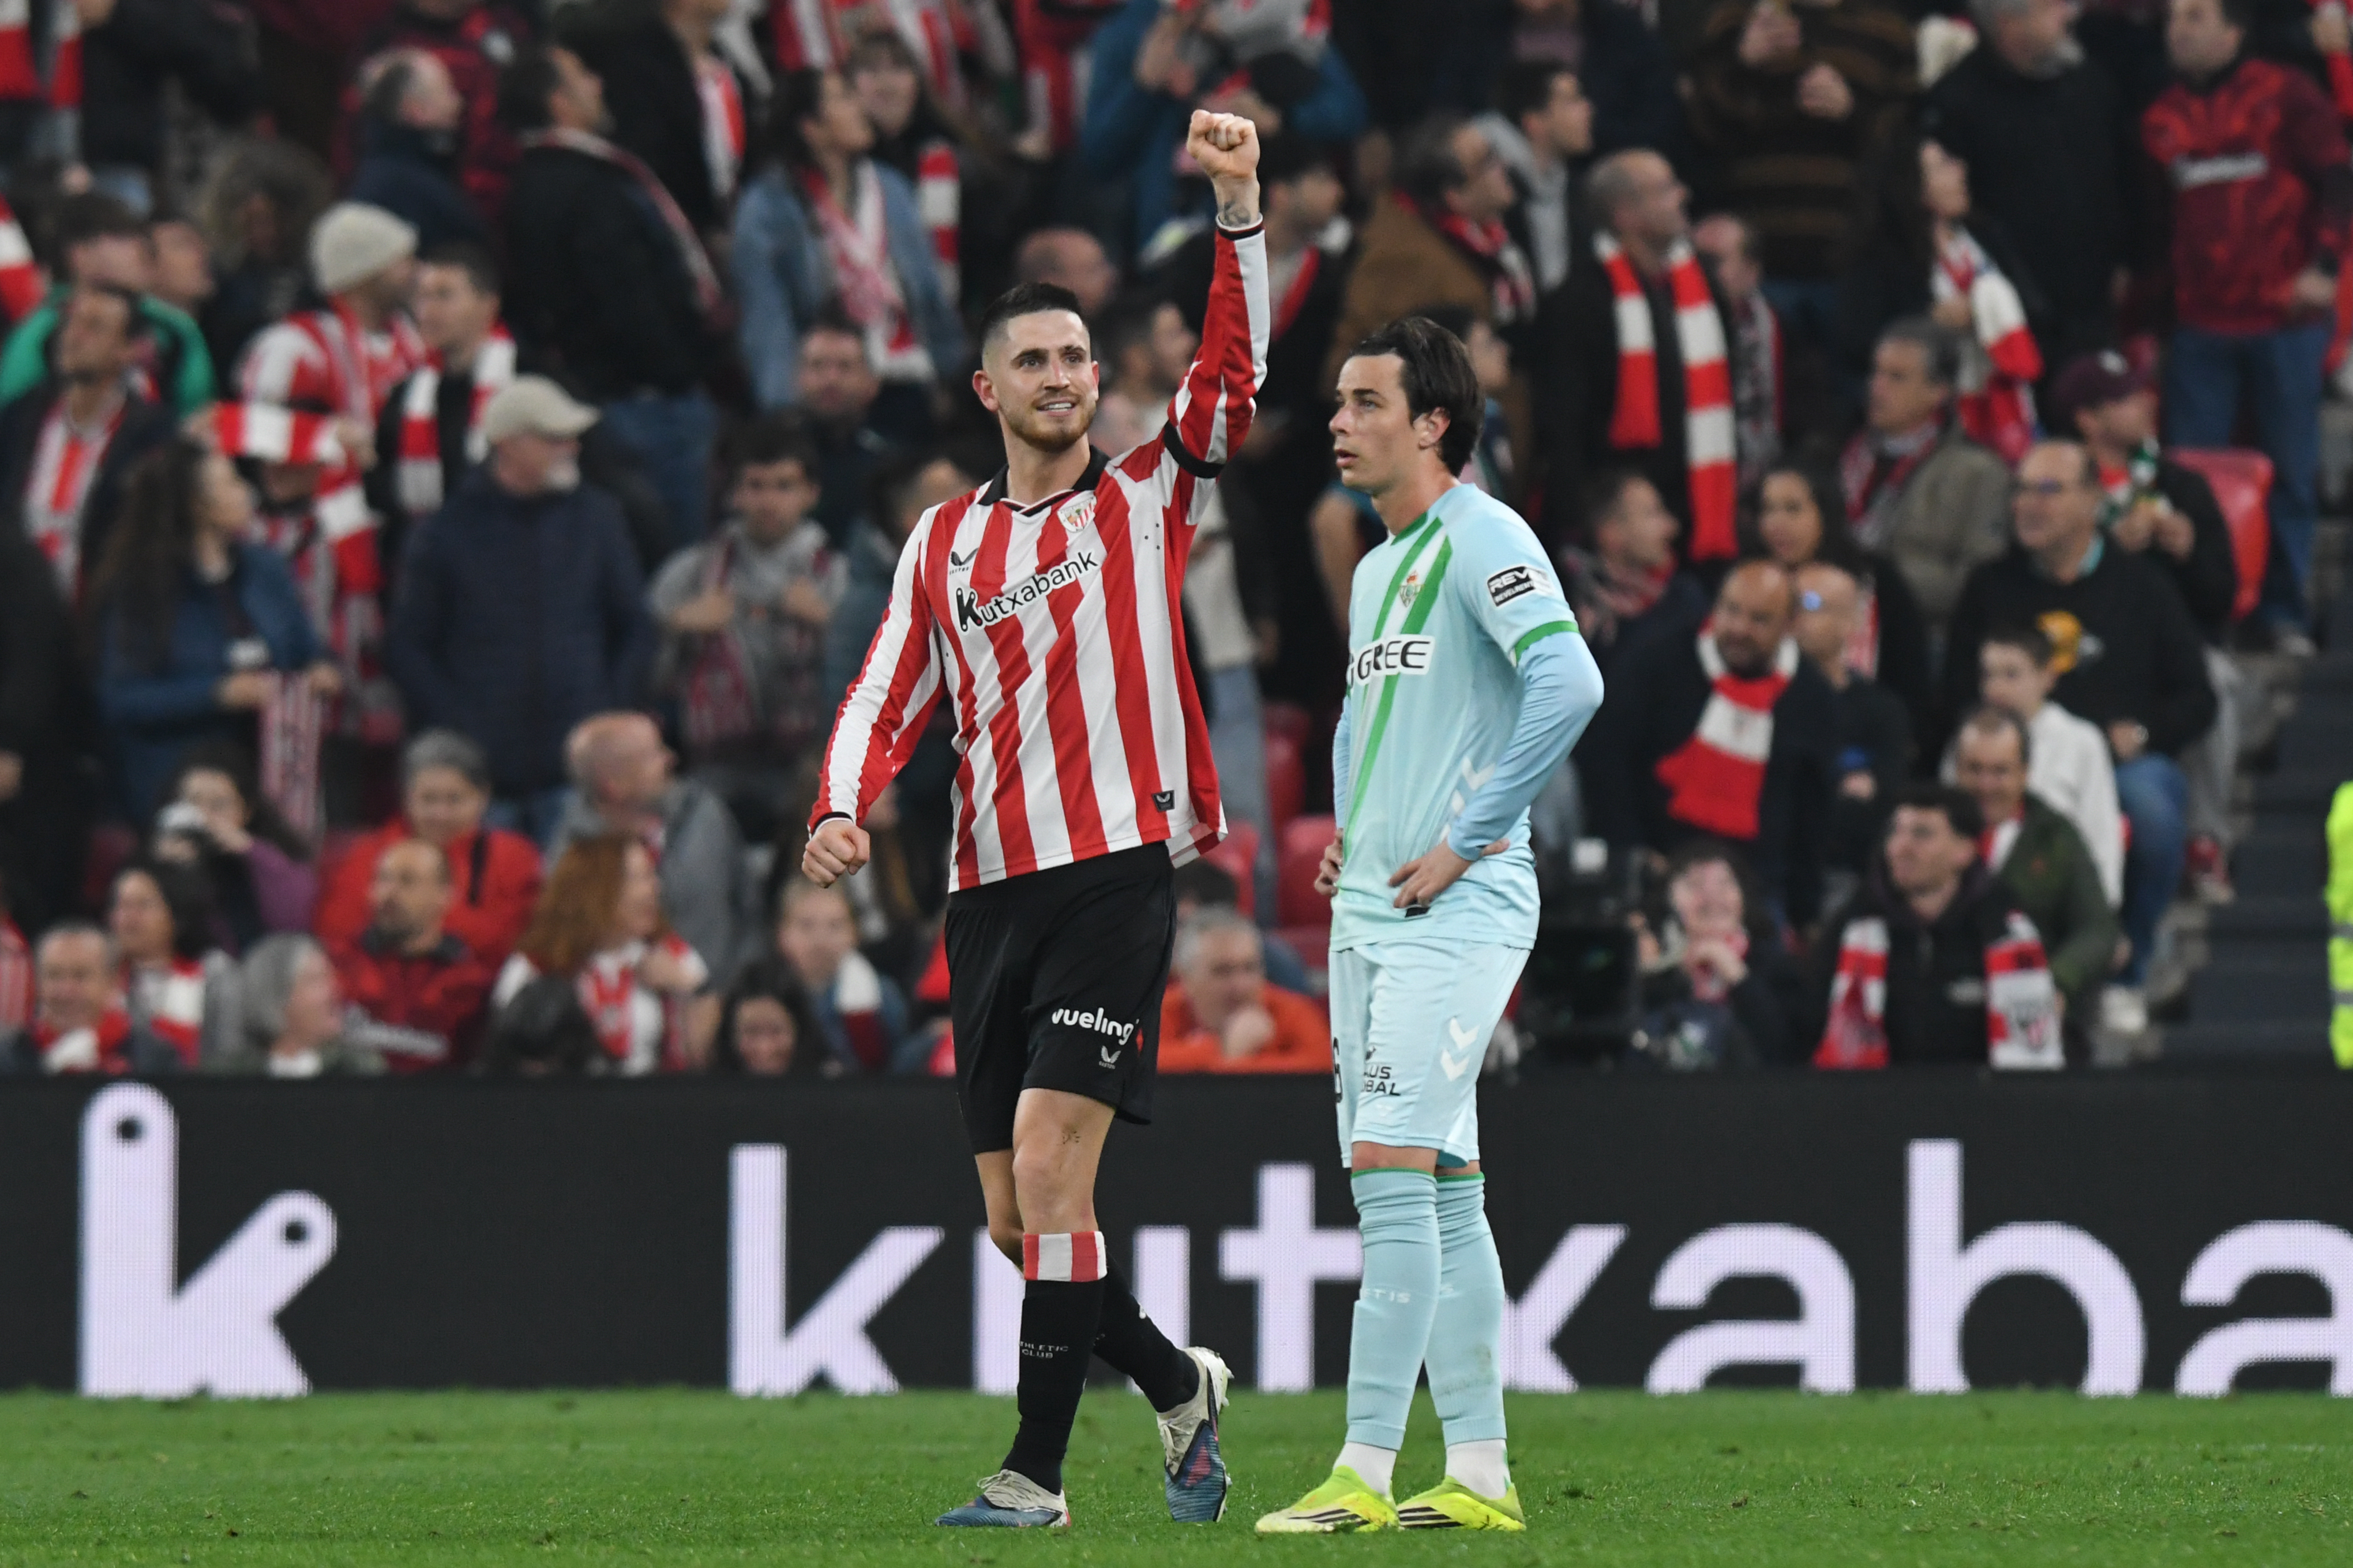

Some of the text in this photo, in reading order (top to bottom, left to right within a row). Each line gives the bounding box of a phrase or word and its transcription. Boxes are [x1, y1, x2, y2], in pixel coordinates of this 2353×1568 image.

[1357, 640, 1431, 680] GREE
[1052, 1007, 1134, 1046] vueling
[1019, 1341, 1069, 1352] THLETIC
